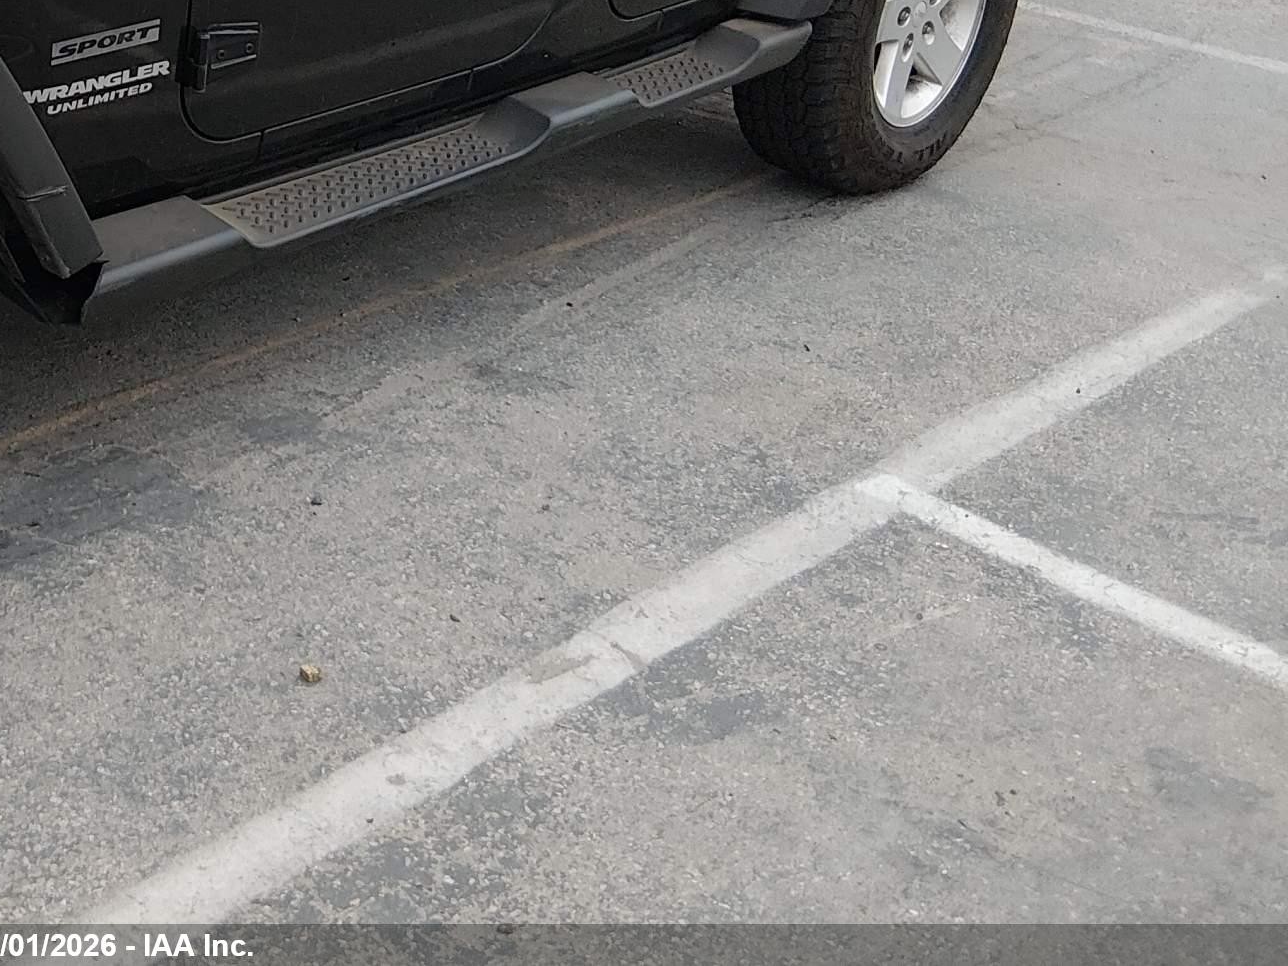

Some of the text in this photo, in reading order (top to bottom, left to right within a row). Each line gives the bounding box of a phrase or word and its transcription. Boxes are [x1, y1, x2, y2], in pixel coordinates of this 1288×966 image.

[56, 26, 158, 58] SPORT
[23, 60, 170, 104] WRANGLER
[47, 82, 153, 115] UNLIMITED
